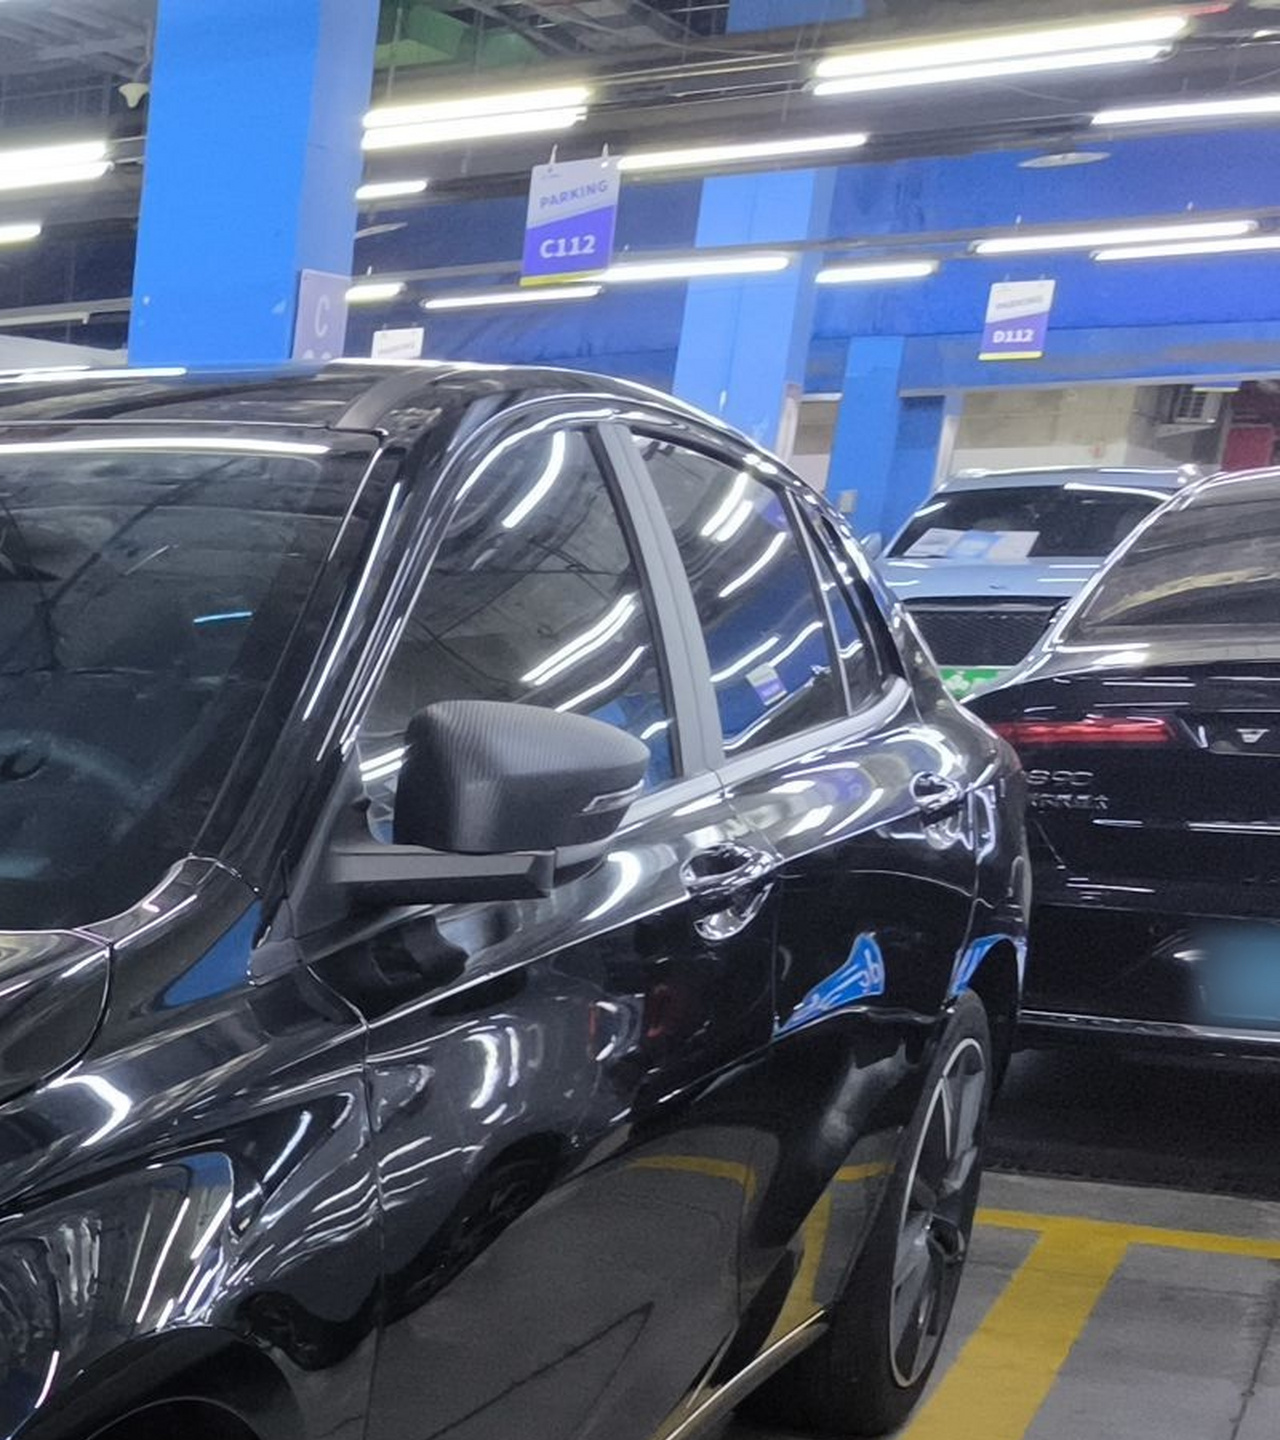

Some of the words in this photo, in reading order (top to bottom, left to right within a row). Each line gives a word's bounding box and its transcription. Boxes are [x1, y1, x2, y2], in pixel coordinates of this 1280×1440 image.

[540, 180, 609, 207] PARKING
[540, 234, 596, 259] C112
[992, 329, 1034, 343] D112
